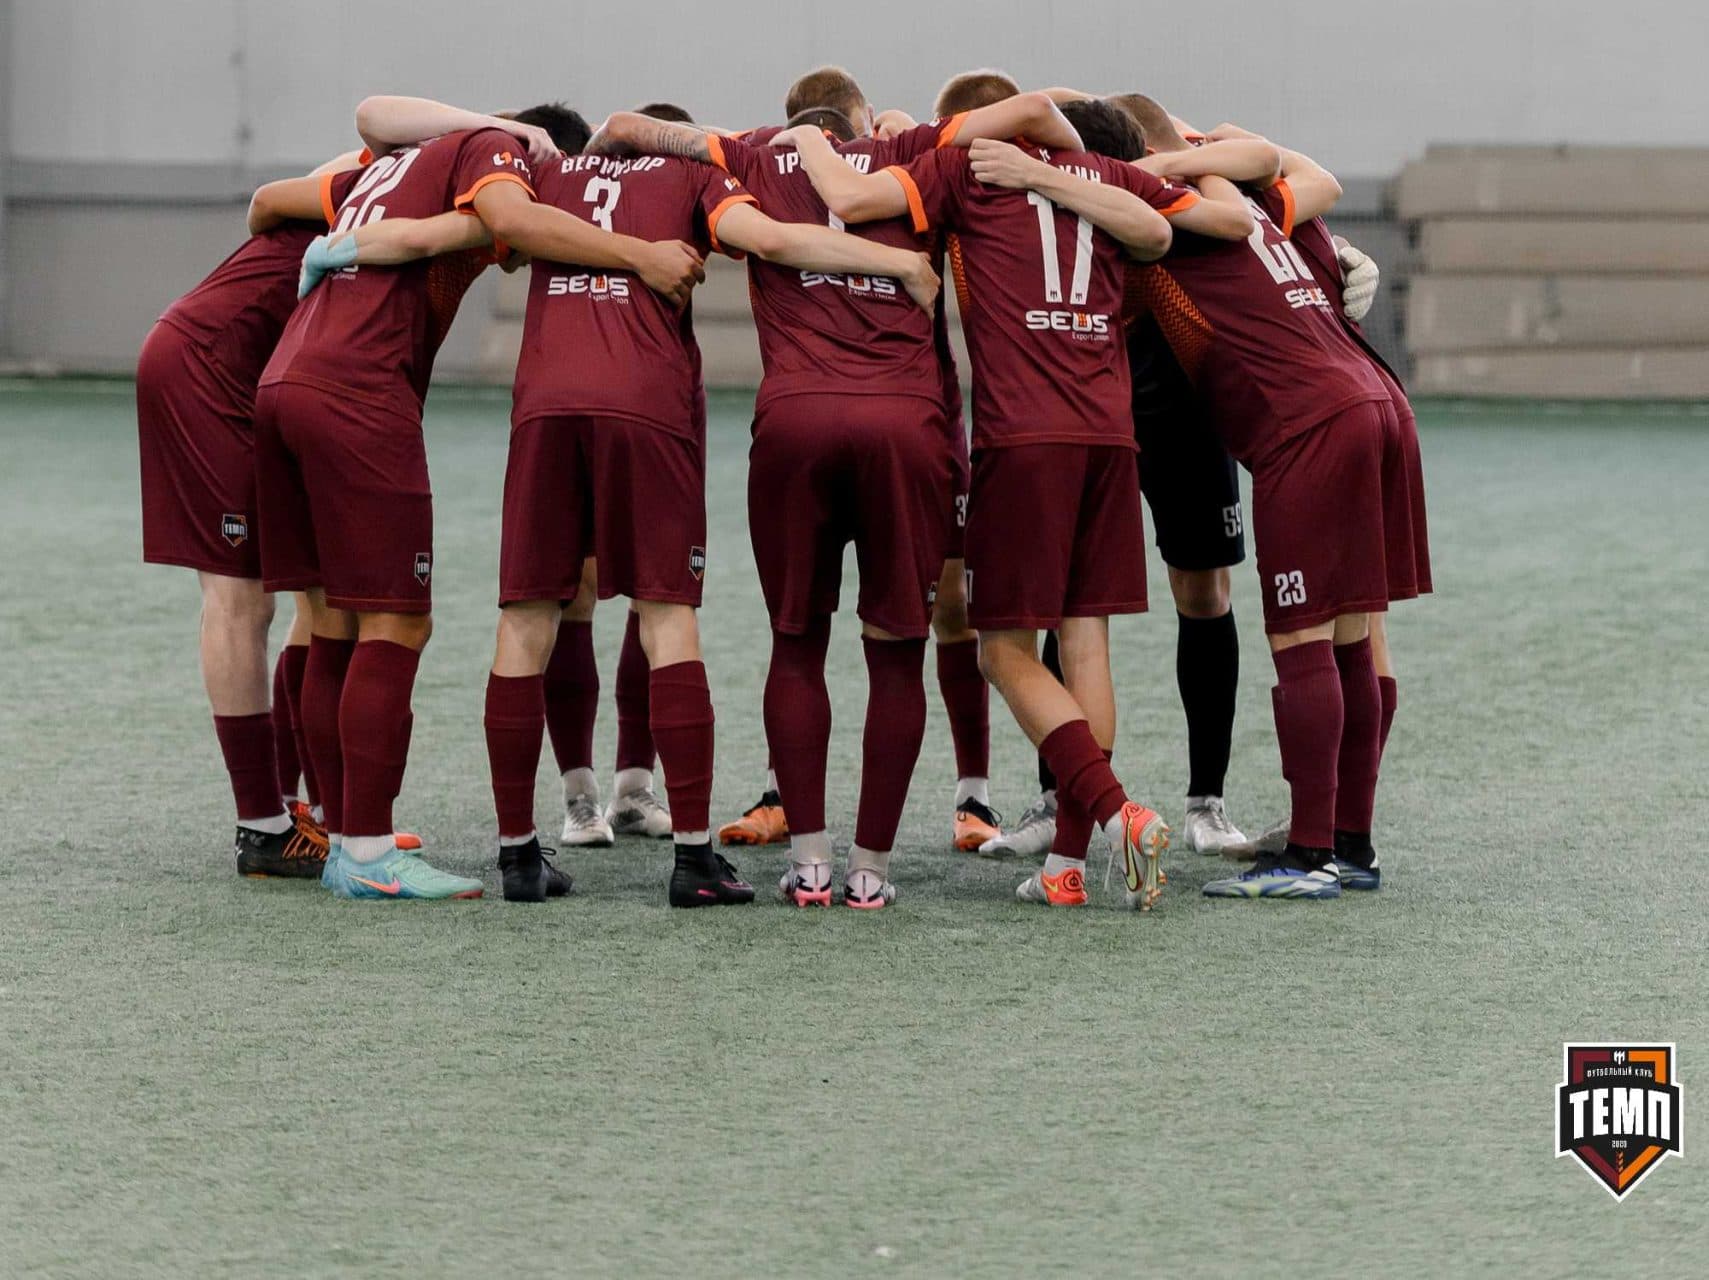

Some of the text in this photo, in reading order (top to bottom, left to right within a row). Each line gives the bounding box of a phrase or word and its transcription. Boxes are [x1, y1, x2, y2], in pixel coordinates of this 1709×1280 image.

[1027, 190, 1093, 305] 17
[547, 274, 630, 296] SEUS
[1025, 310, 1109, 333] SEUS
[1274, 570, 1307, 607] 23
